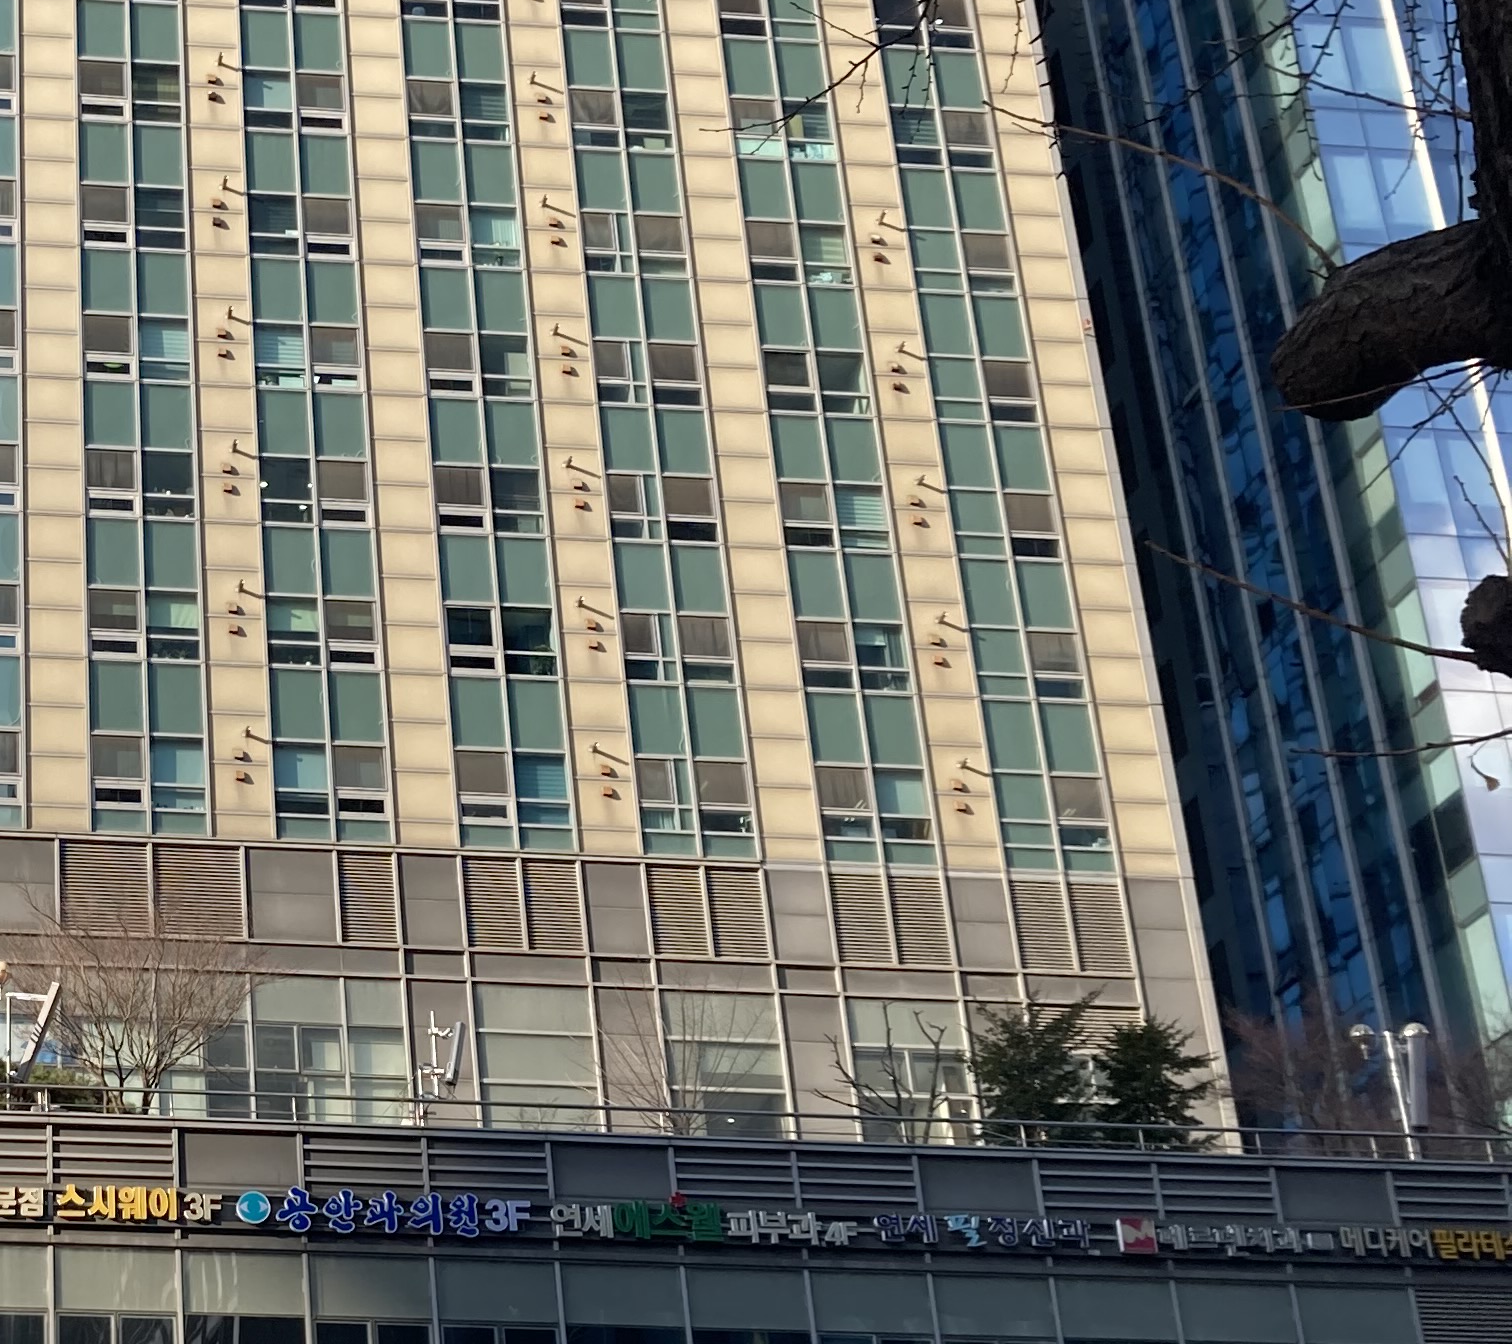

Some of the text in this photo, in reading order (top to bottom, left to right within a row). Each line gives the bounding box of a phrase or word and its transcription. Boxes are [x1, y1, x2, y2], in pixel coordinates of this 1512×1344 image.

[57, 1183, 178, 1221] 스시웨이
[183, 1191, 223, 1221] 3F
[275, 1186, 532, 1238] 공안과의원 3F
